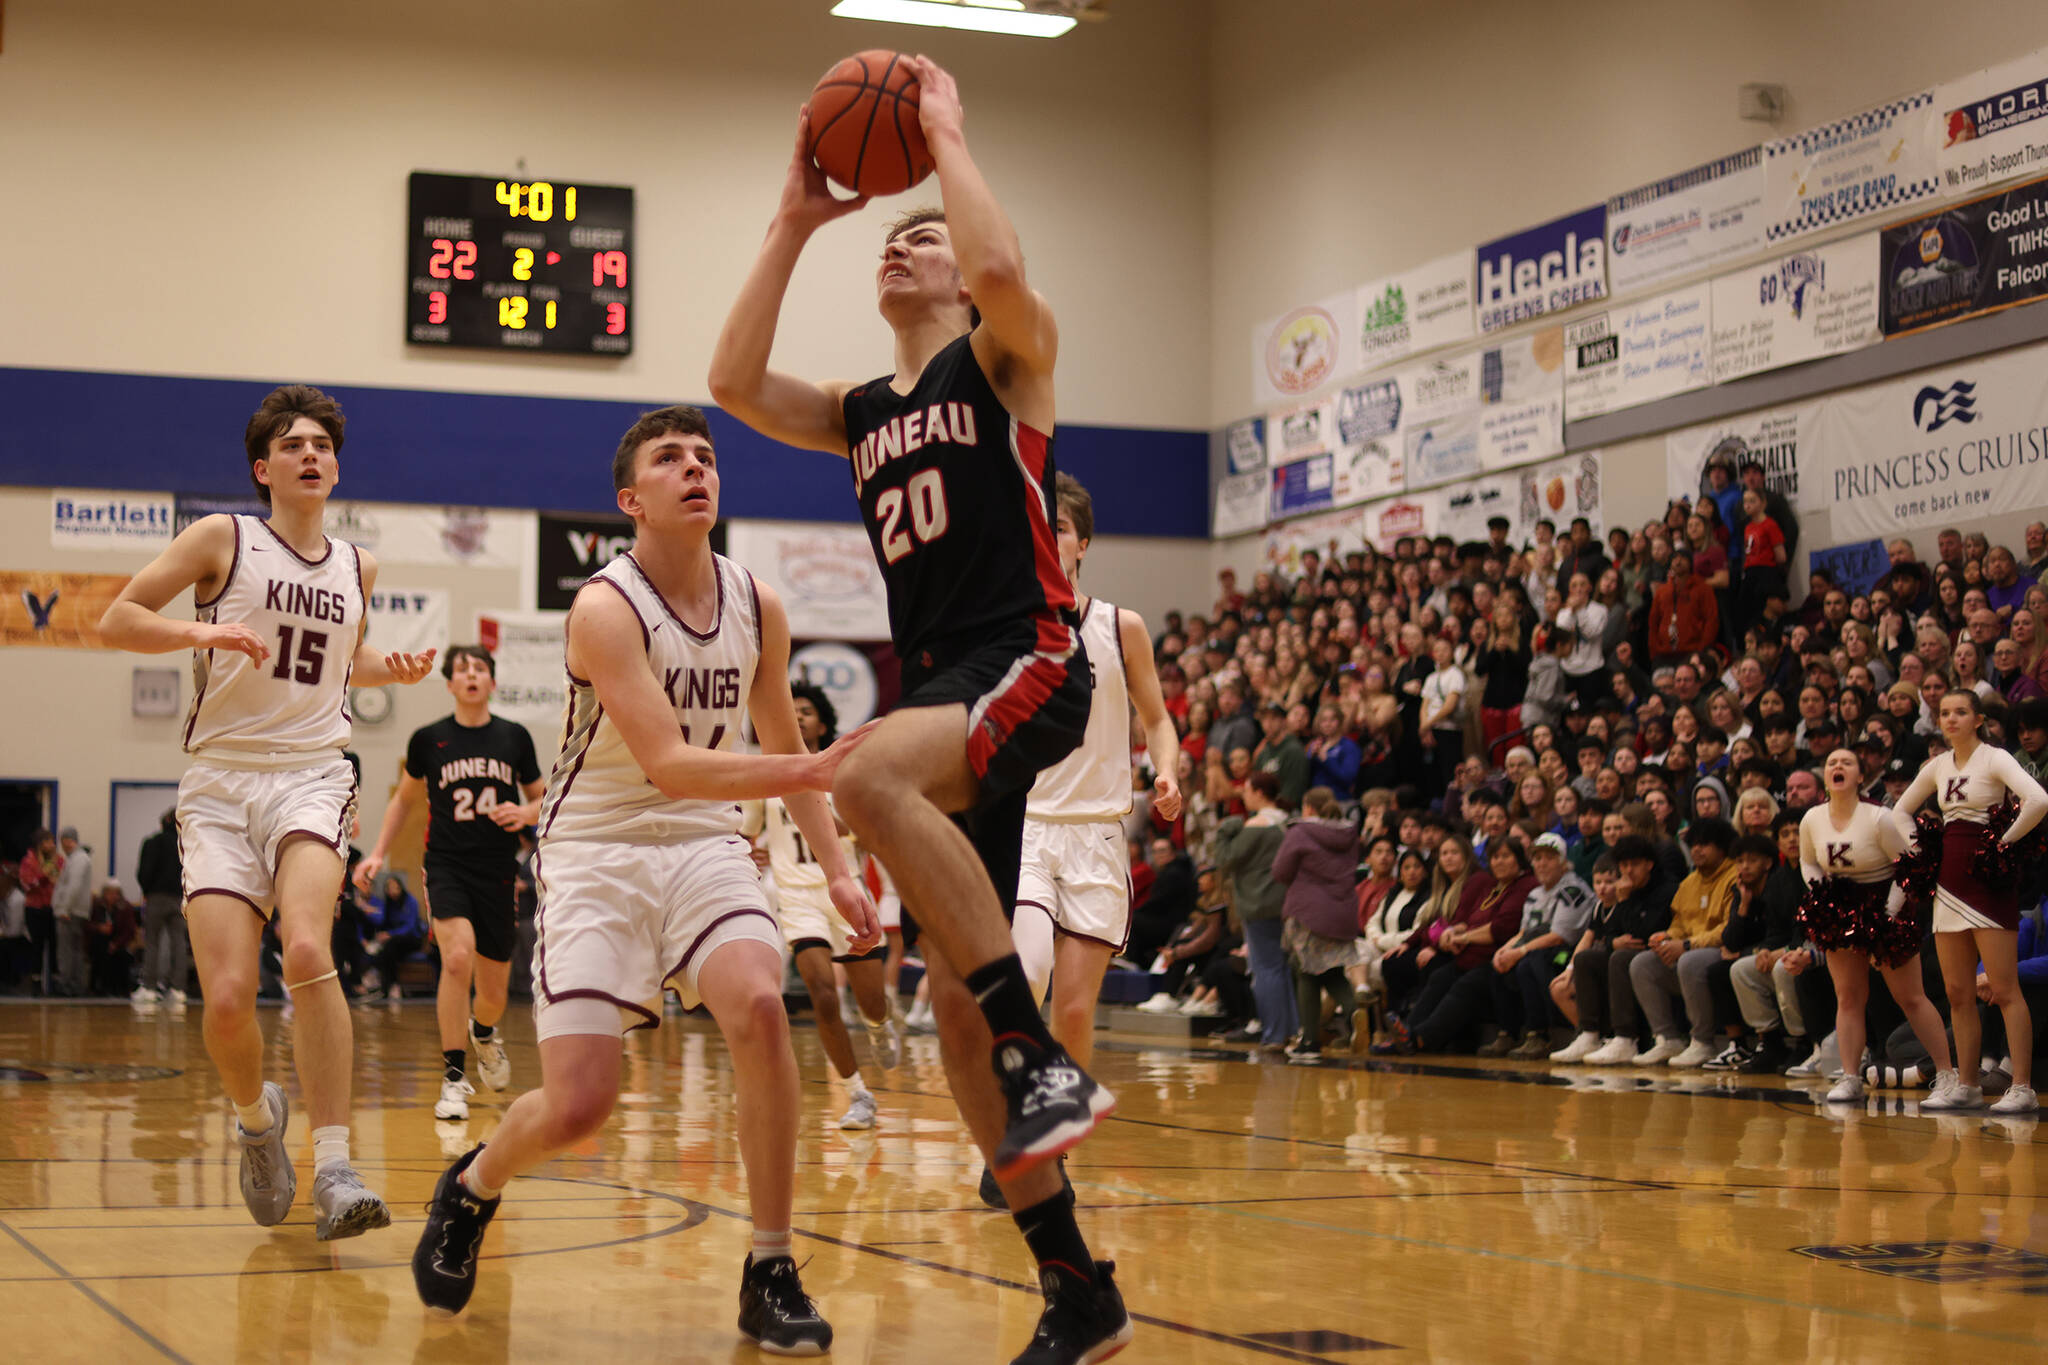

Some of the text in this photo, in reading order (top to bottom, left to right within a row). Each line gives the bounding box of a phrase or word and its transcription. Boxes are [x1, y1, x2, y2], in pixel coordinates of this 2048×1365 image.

[1990, 149, 2024, 175] Support
[495, 181, 577, 222] 4:01
[1837, 183, 1860, 205] PEP
[1863, 173, 1896, 200] BAND
[1987, 201, 2030, 232] Good
[429, 239, 478, 281] 22
[512, 248, 534, 281] 2
[592, 250, 628, 288] 19
[1480, 231, 1606, 304] Hecla
[1760, 273, 1777, 306] GO
[428, 291, 447, 324] 3
[545, 300, 557, 329] 1
[606, 302, 626, 335] 3
[1481, 295, 1545, 332] GREENS
[852, 401, 977, 500] JUNEAU
[1834, 447, 1950, 501] PRINCESS
[56, 501, 168, 524] Bartlett
[875, 466, 949, 566] 20
[1894, 487, 1992, 519] come back new
[265, 579, 345, 625] KINGS
[272, 624, 329, 686] 15
[664, 667, 740, 710] KINGS
[438, 757, 513, 790] JUNEAU
[1944, 776, 1970, 803] K
[452, 786, 498, 821] 24
[1827, 842, 1855, 868] K
